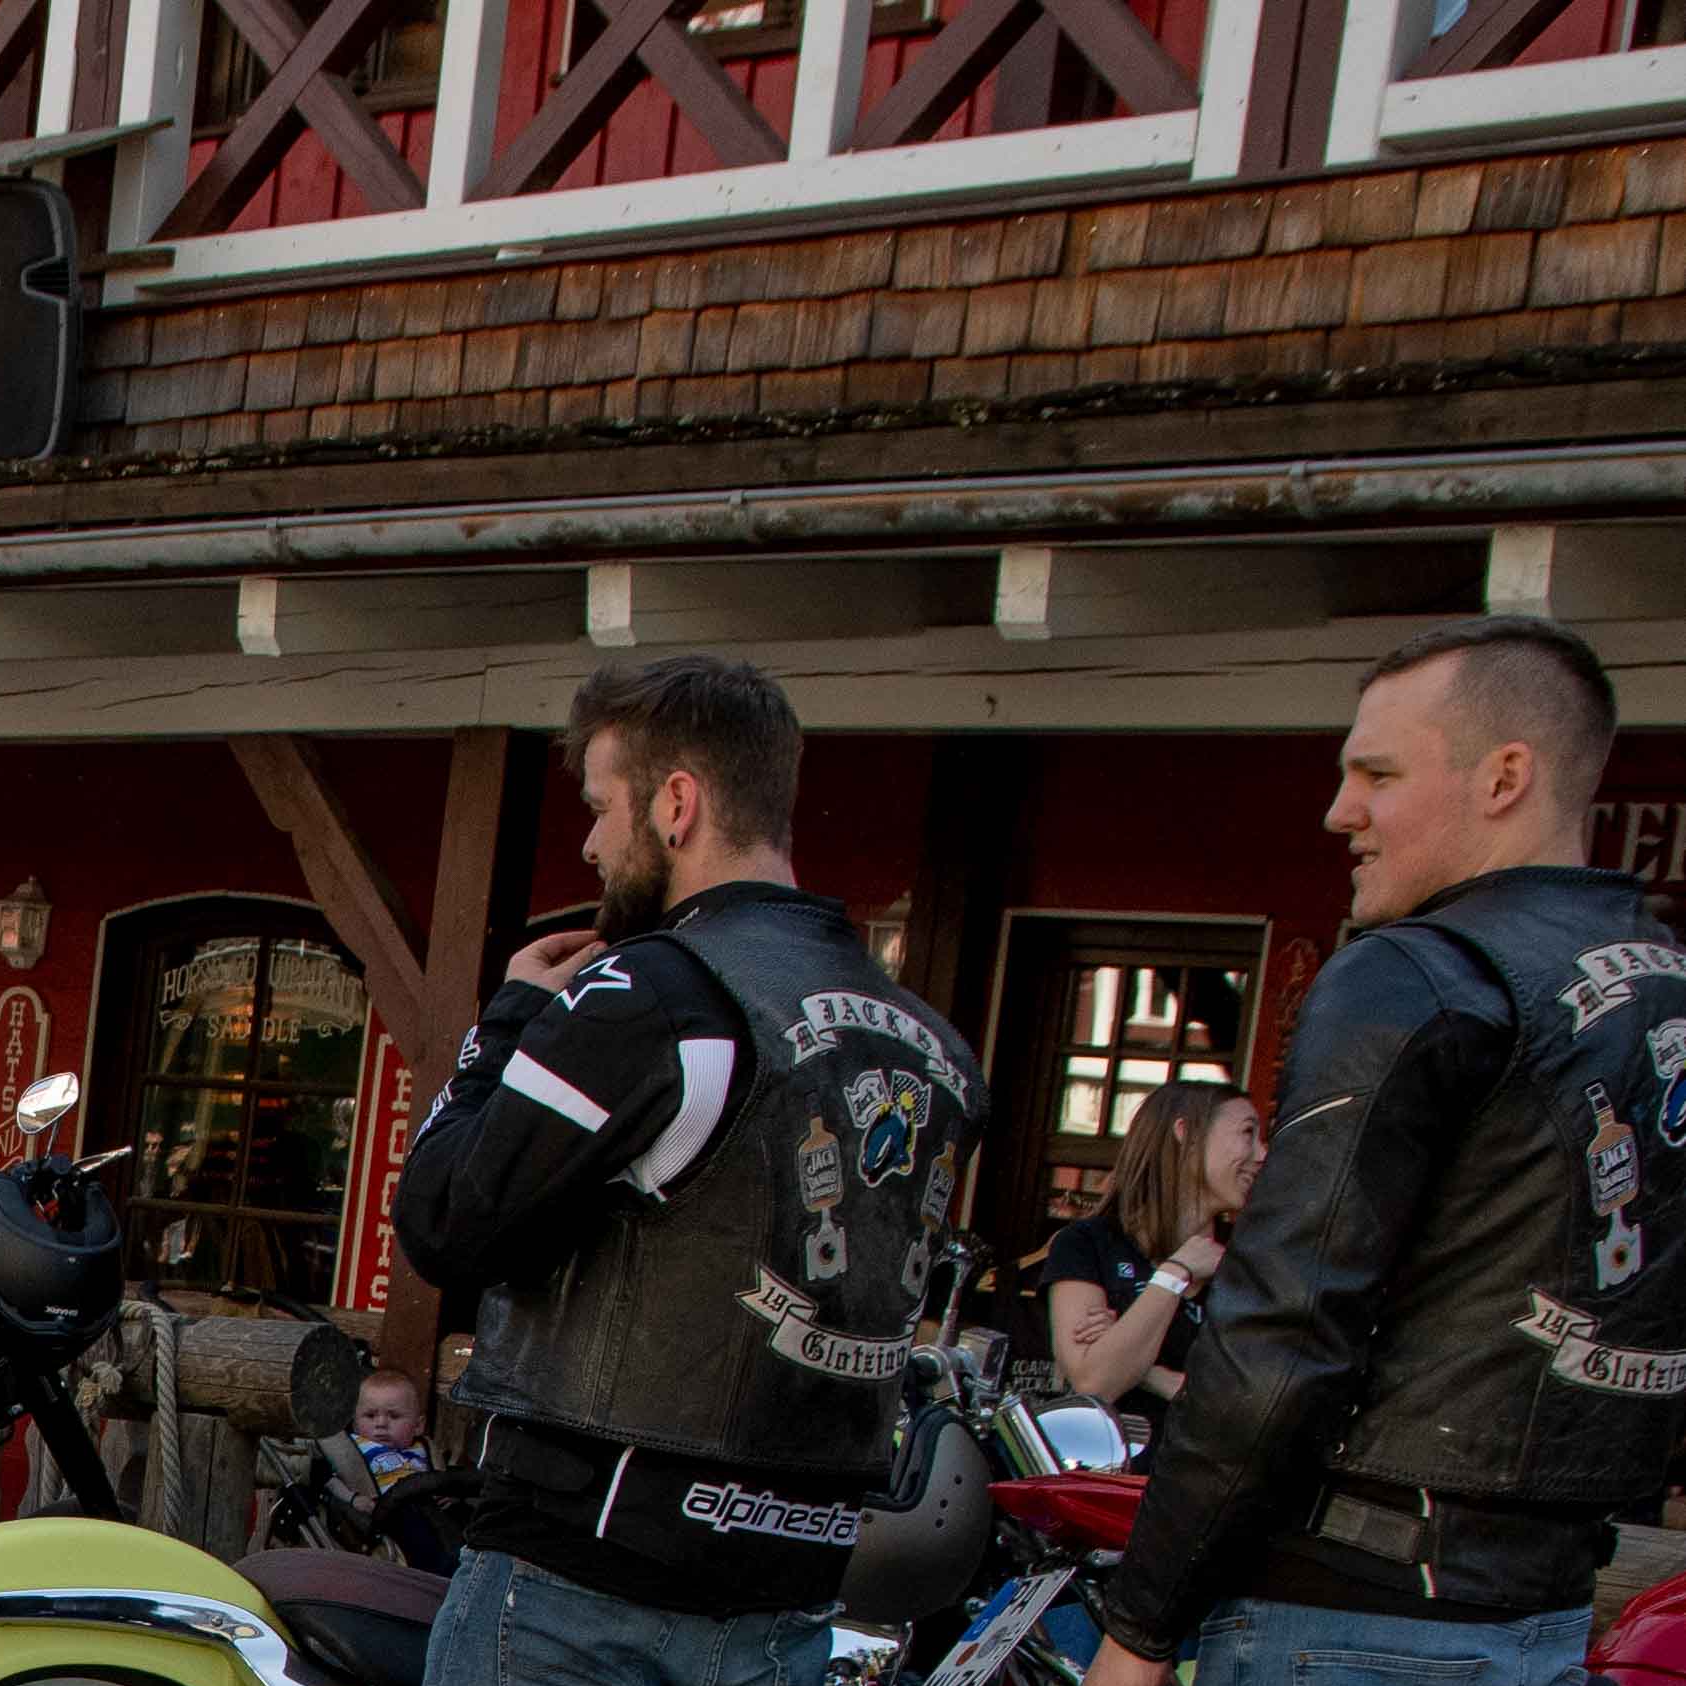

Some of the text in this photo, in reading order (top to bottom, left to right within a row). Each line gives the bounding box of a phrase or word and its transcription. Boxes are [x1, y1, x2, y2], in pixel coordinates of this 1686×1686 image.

[817, 997, 933, 1051] JACK'S
[1, 1001, 26, 1113] HATS
[759, 1286, 788, 1312] 19
[1536, 1309, 1569, 1335] 19
[685, 1485, 859, 1541] alpinesta
